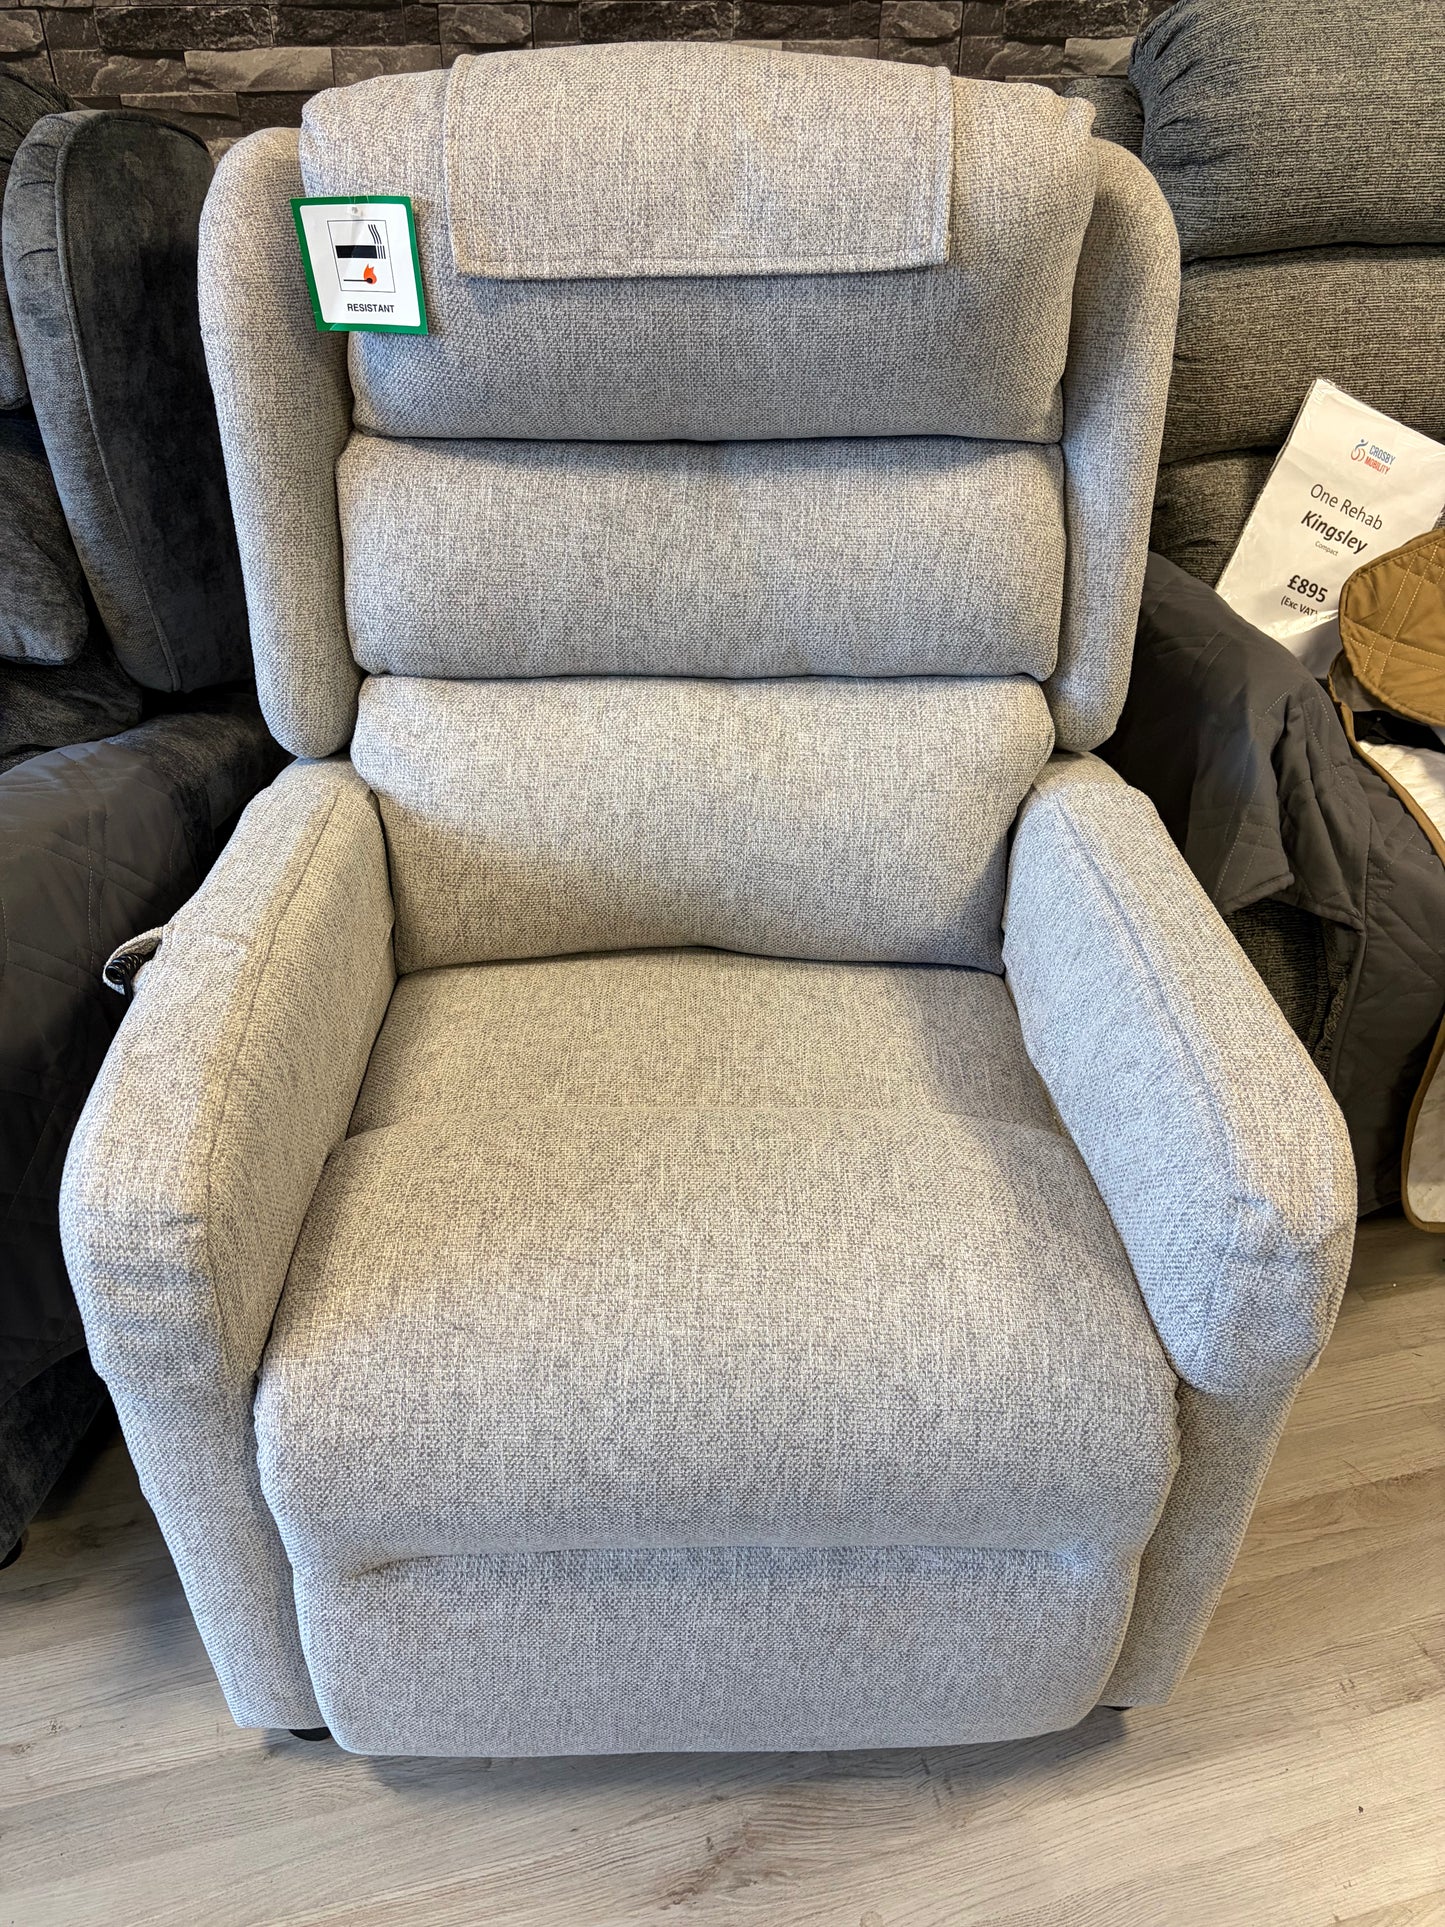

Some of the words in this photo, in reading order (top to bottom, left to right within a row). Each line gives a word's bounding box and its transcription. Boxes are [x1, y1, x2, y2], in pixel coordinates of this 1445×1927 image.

[347, 303, 394, 313] RESISTANT
[1369, 445, 1395, 465] CROSBY
[1364, 457, 1390, 475] MOBILITY
[1310, 484, 1338, 508] One
[1340, 499, 1383, 530] Rehab
[1301, 511, 1368, 554] Kingsley
[1315, 541, 1339, 556] Compact
[1287, 574, 1328, 602] £895
[1280, 595, 1298, 610] (Exc
